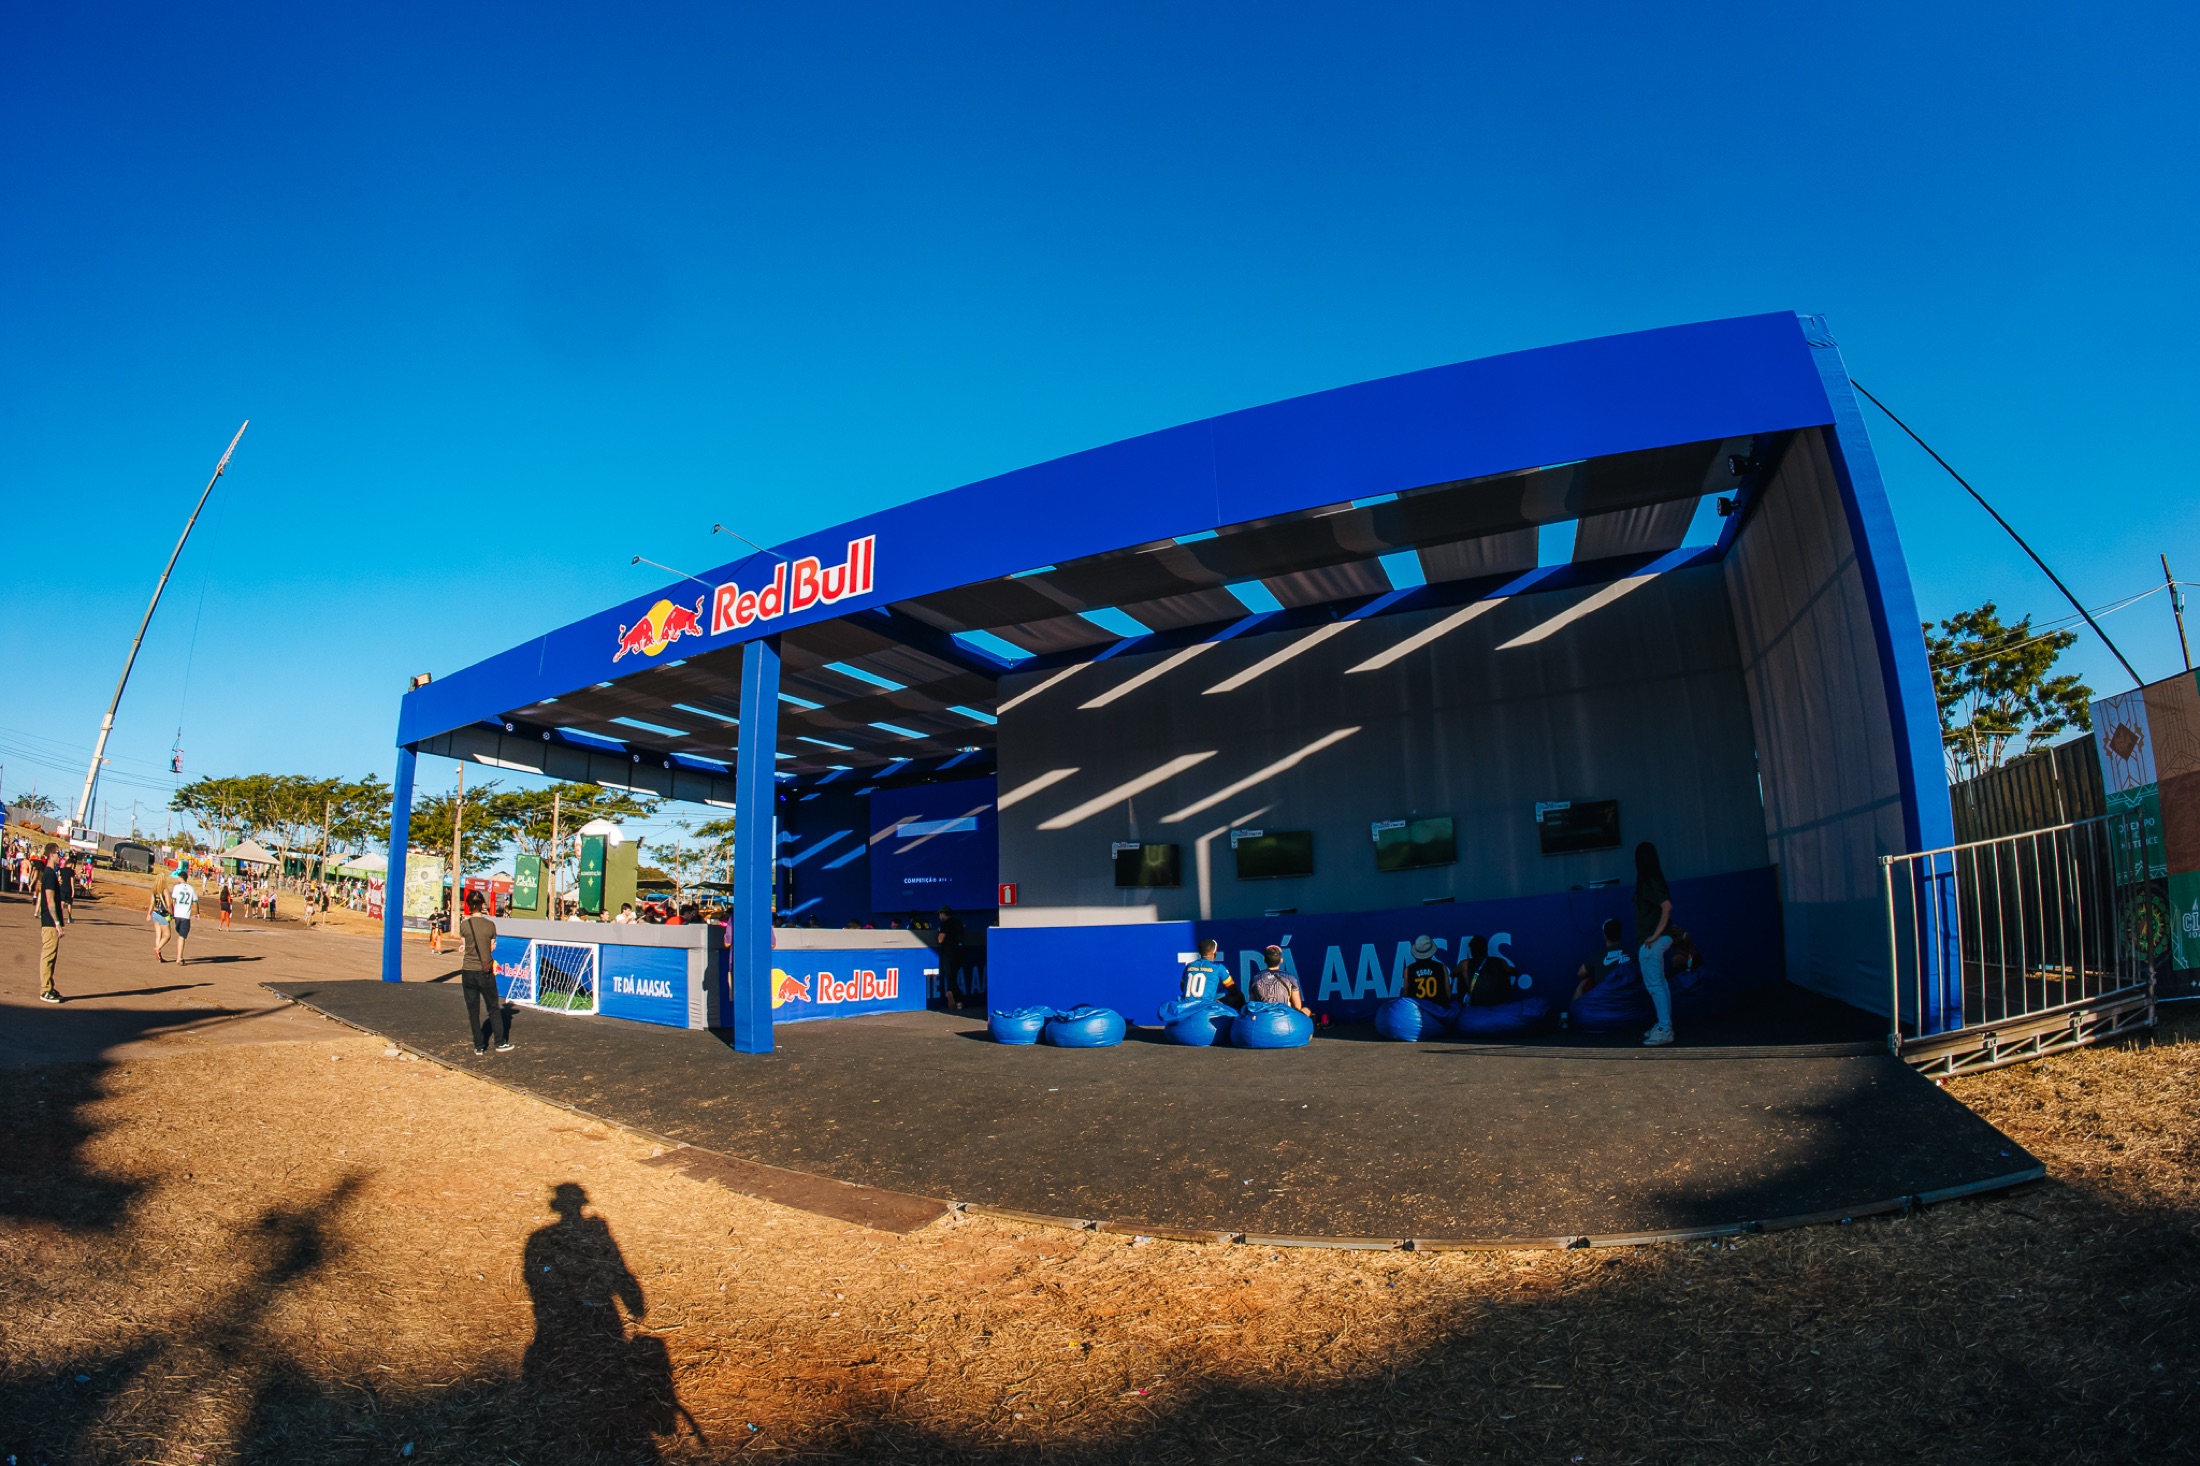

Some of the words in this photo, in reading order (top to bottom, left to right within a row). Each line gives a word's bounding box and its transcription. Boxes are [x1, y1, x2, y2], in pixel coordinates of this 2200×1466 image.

[711, 561, 787, 636] Red
[789, 534, 876, 613] Bull
[517, 875, 537, 884] PLAY
[178, 891, 191, 905] 22
[613, 976, 622, 992] TE
[623, 974, 635, 994] DÁ
[636, 978, 674, 998] AAASAS.
[817, 969, 860, 1004] Red
[860, 968, 899, 1001] Bull
[1186, 972, 1207, 998] 10
[1414, 976, 1437, 999] 30
